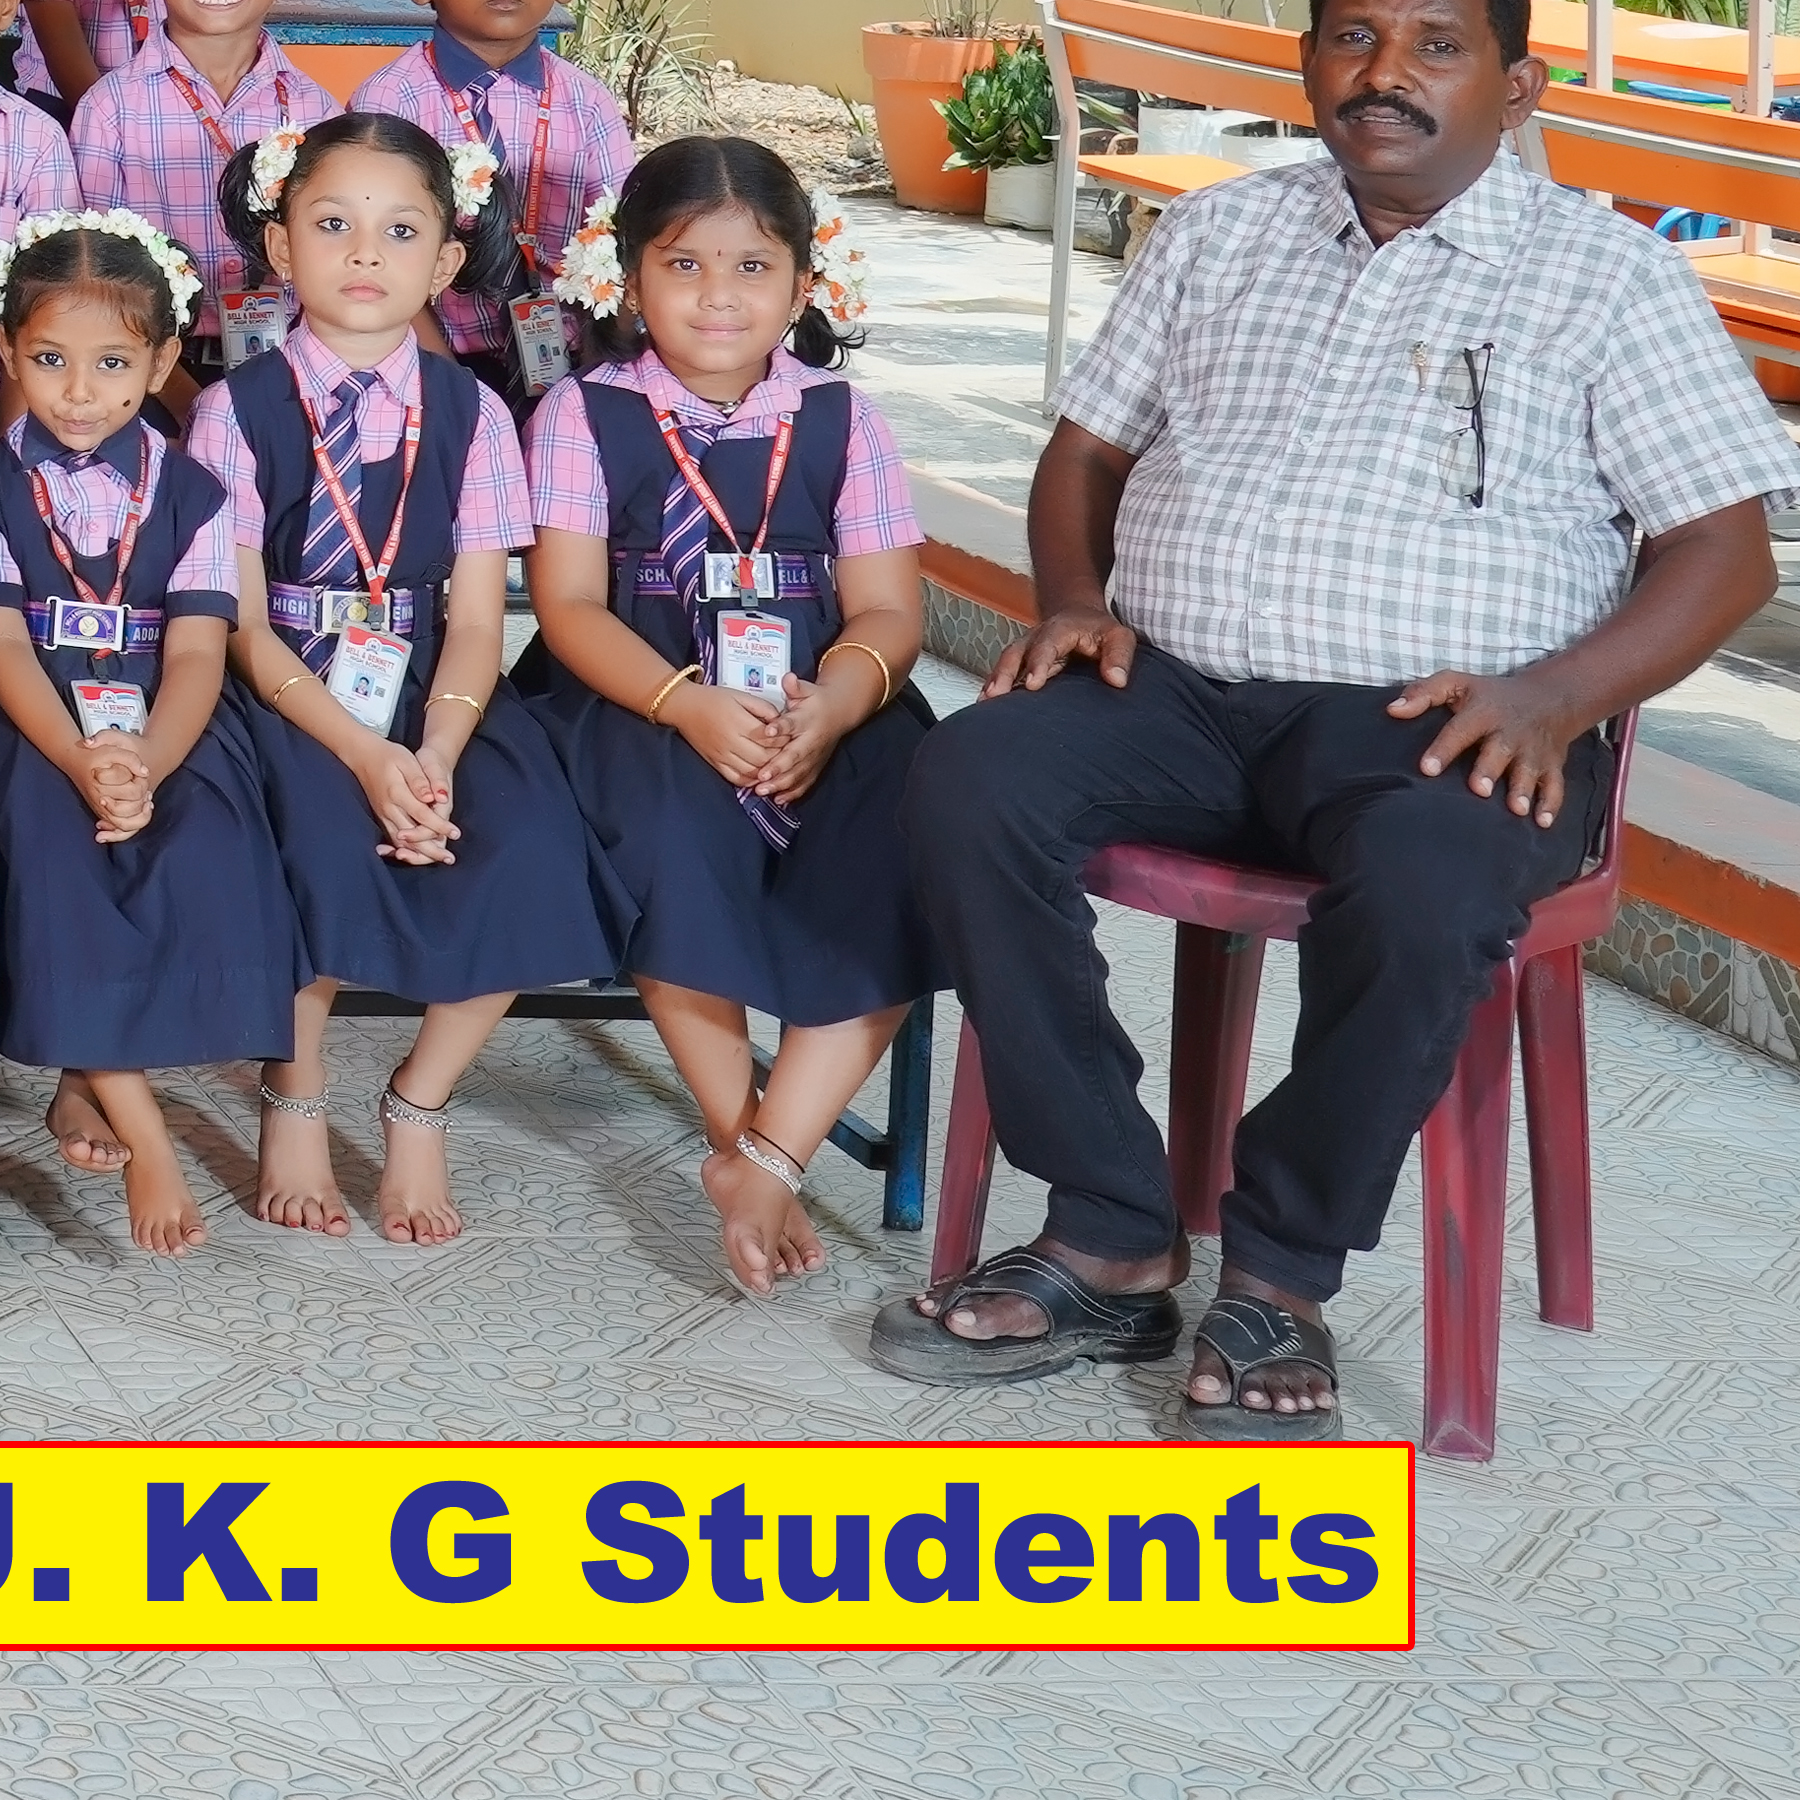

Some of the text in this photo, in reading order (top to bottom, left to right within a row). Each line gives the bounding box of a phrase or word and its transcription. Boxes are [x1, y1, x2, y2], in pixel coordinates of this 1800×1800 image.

[778, 567, 799, 584] ELL
[273, 596, 308, 617] HIGH
[751, 642, 779, 653] BENNETT
